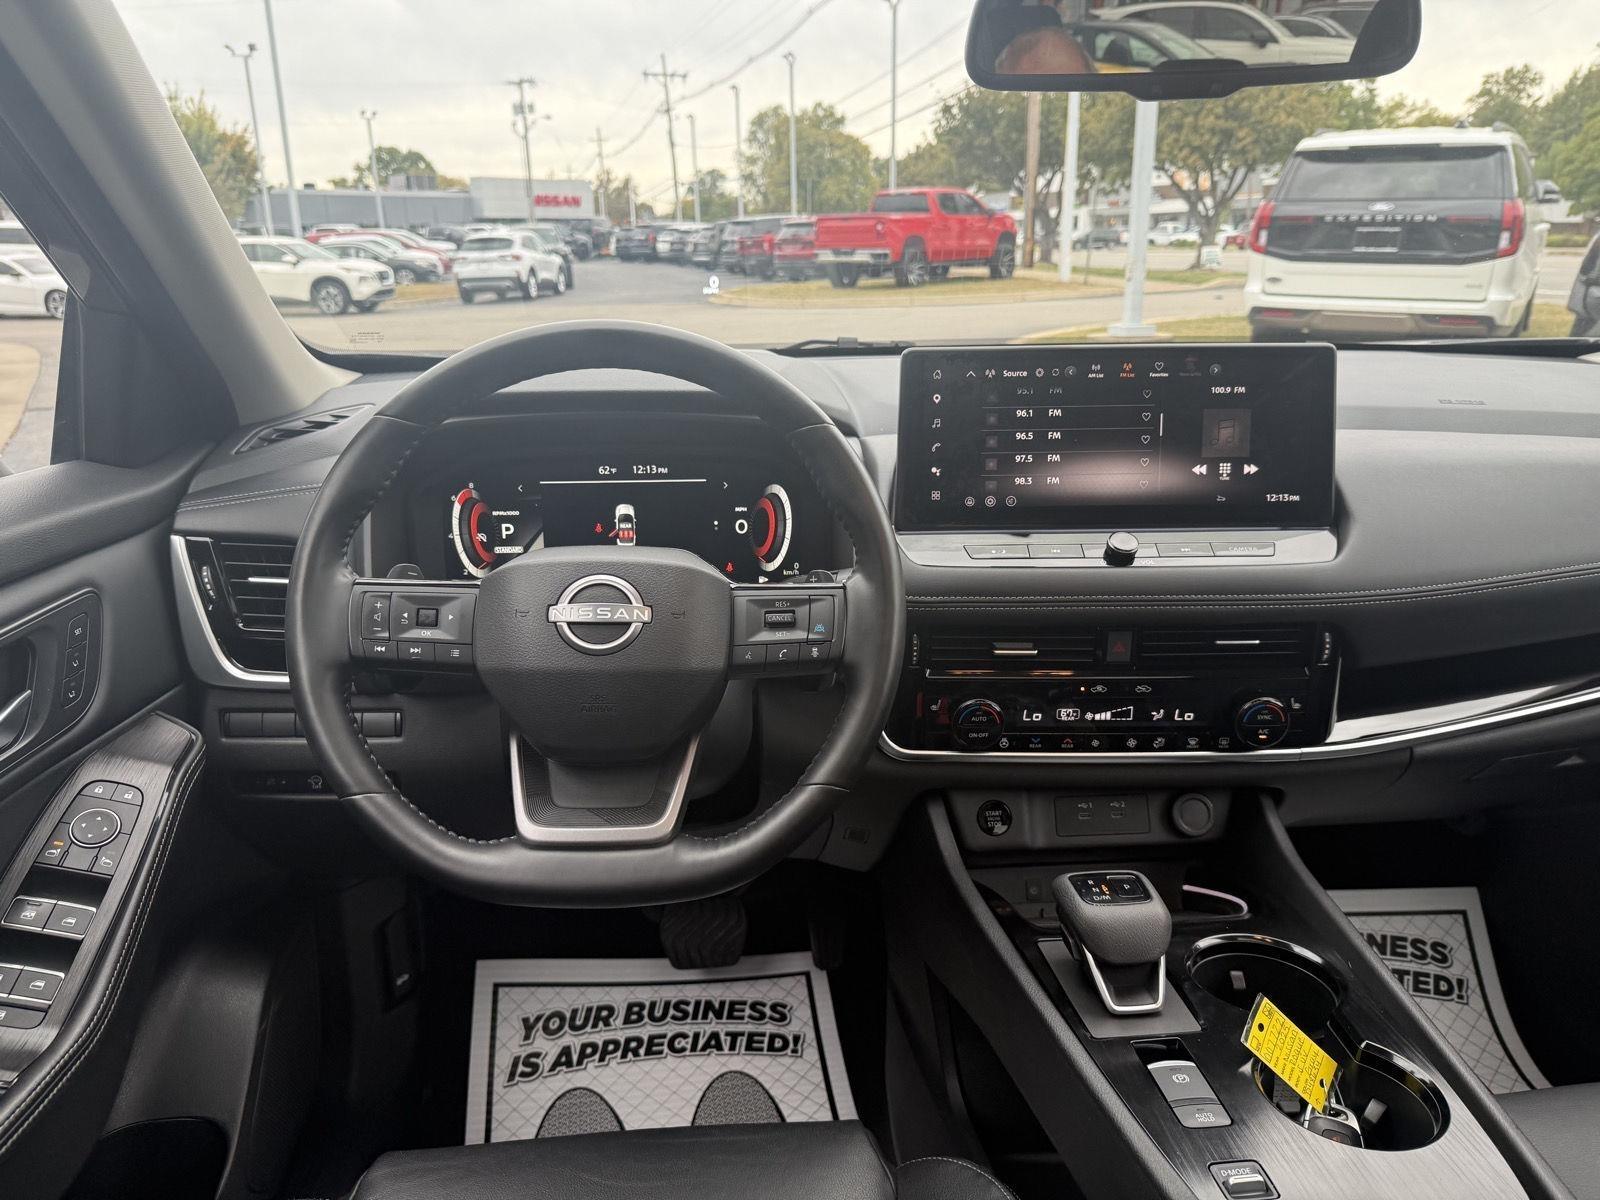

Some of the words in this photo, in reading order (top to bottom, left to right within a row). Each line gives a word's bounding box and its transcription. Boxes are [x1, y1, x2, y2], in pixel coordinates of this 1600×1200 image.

[1324, 213, 1438, 223] EXPEDITION
[1002, 369, 1028, 377] Source
[1210, 386, 1231, 394] 100.9
[1233, 386, 1246, 394] FM
[1016, 409, 1033, 418] 96.1
[1048, 409, 1062, 417] FM
[1015, 432, 1034, 440] 96.5
[1047, 431, 1061, 440] FM
[1015, 454, 1033, 463] 97.5
[1047, 454, 1061, 462] FM
[1014, 477, 1033, 485] 98.3
[1046, 476, 1060, 485] FM
[501, 523, 515, 540] P
[734, 518, 749, 535] 0
[552, 608, 648, 620] NISSAN
[1022, 709, 1042, 721] Lo
[1174, 709, 1195, 721] Lo
[1360, 932, 1451, 965] NESS
[1391, 967, 1466, 1001] TED!
[521, 1004, 617, 1043] YOUR
[622, 999, 791, 1026] BUSINESS
[507, 1052, 545, 1083] IS
[549, 1030, 803, 1073] APPRECIATED!
[1220, 1167, 1252, 1177] D-MODE
